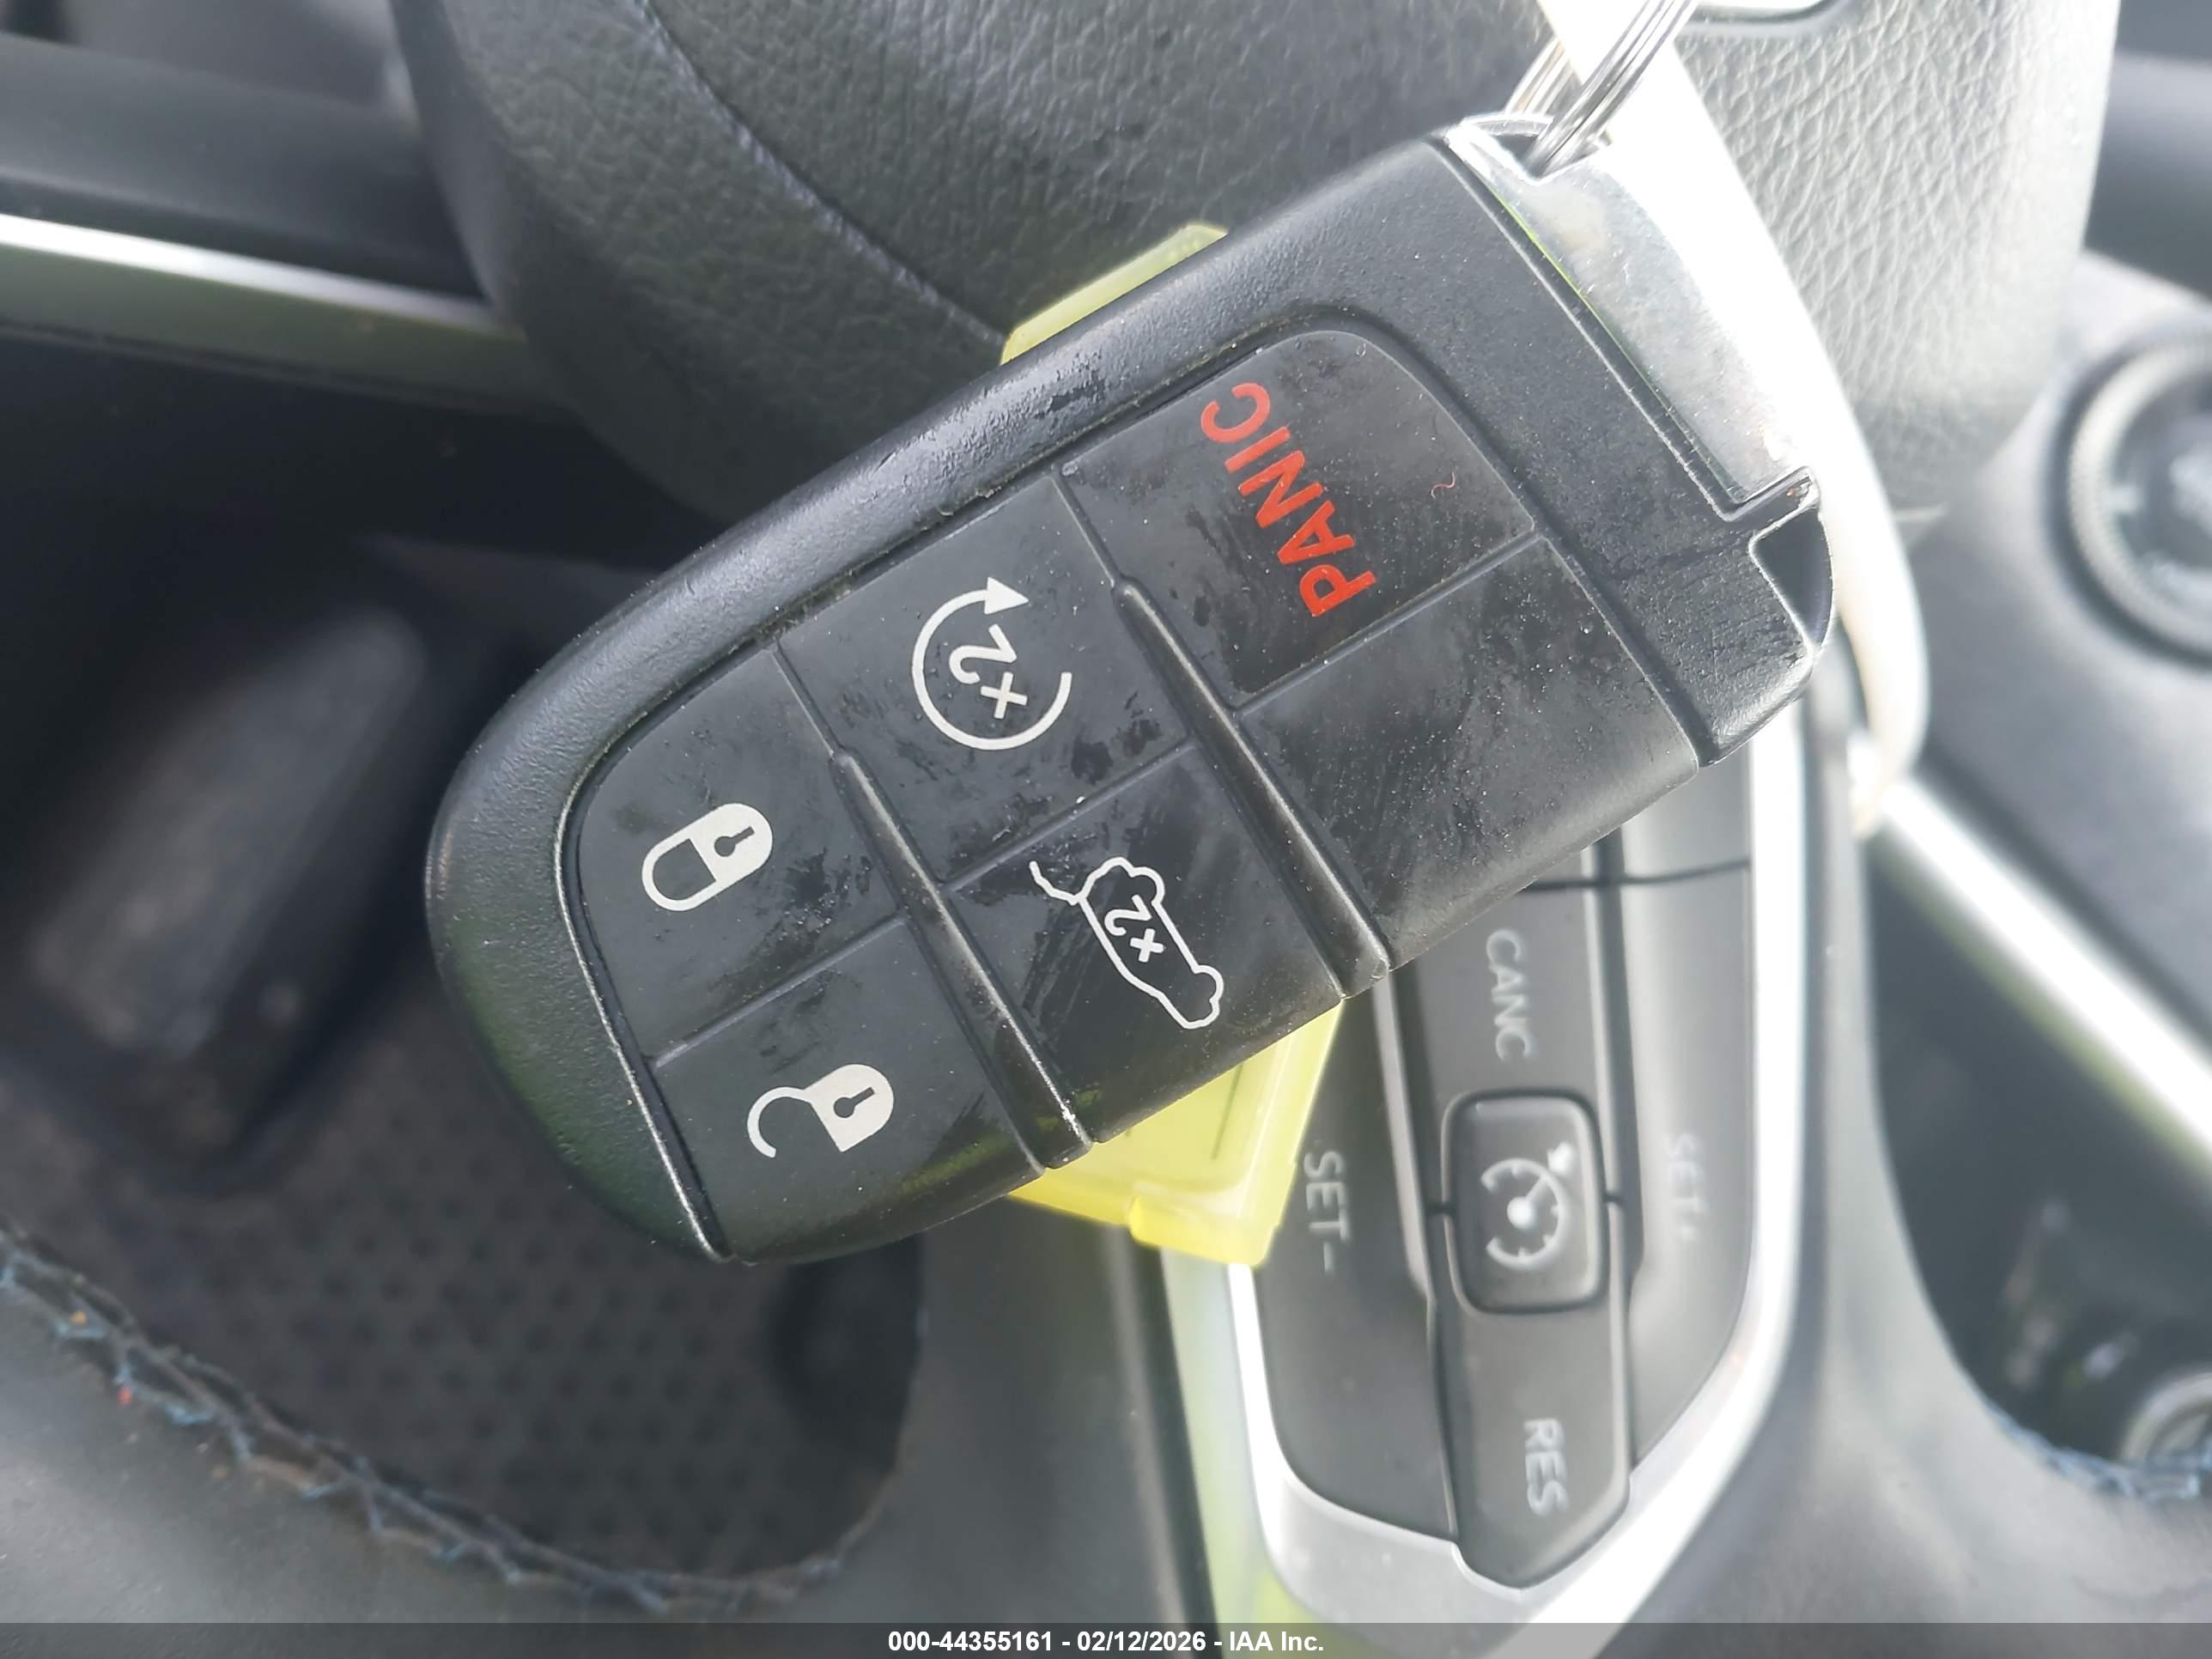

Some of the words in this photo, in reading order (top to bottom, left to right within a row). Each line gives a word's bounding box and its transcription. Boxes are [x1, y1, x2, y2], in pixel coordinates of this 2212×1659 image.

[1200, 382, 1376, 617] PANIC
[1486, 928, 1534, 1061] CANC
[1523, 1418, 1568, 1516] RES
